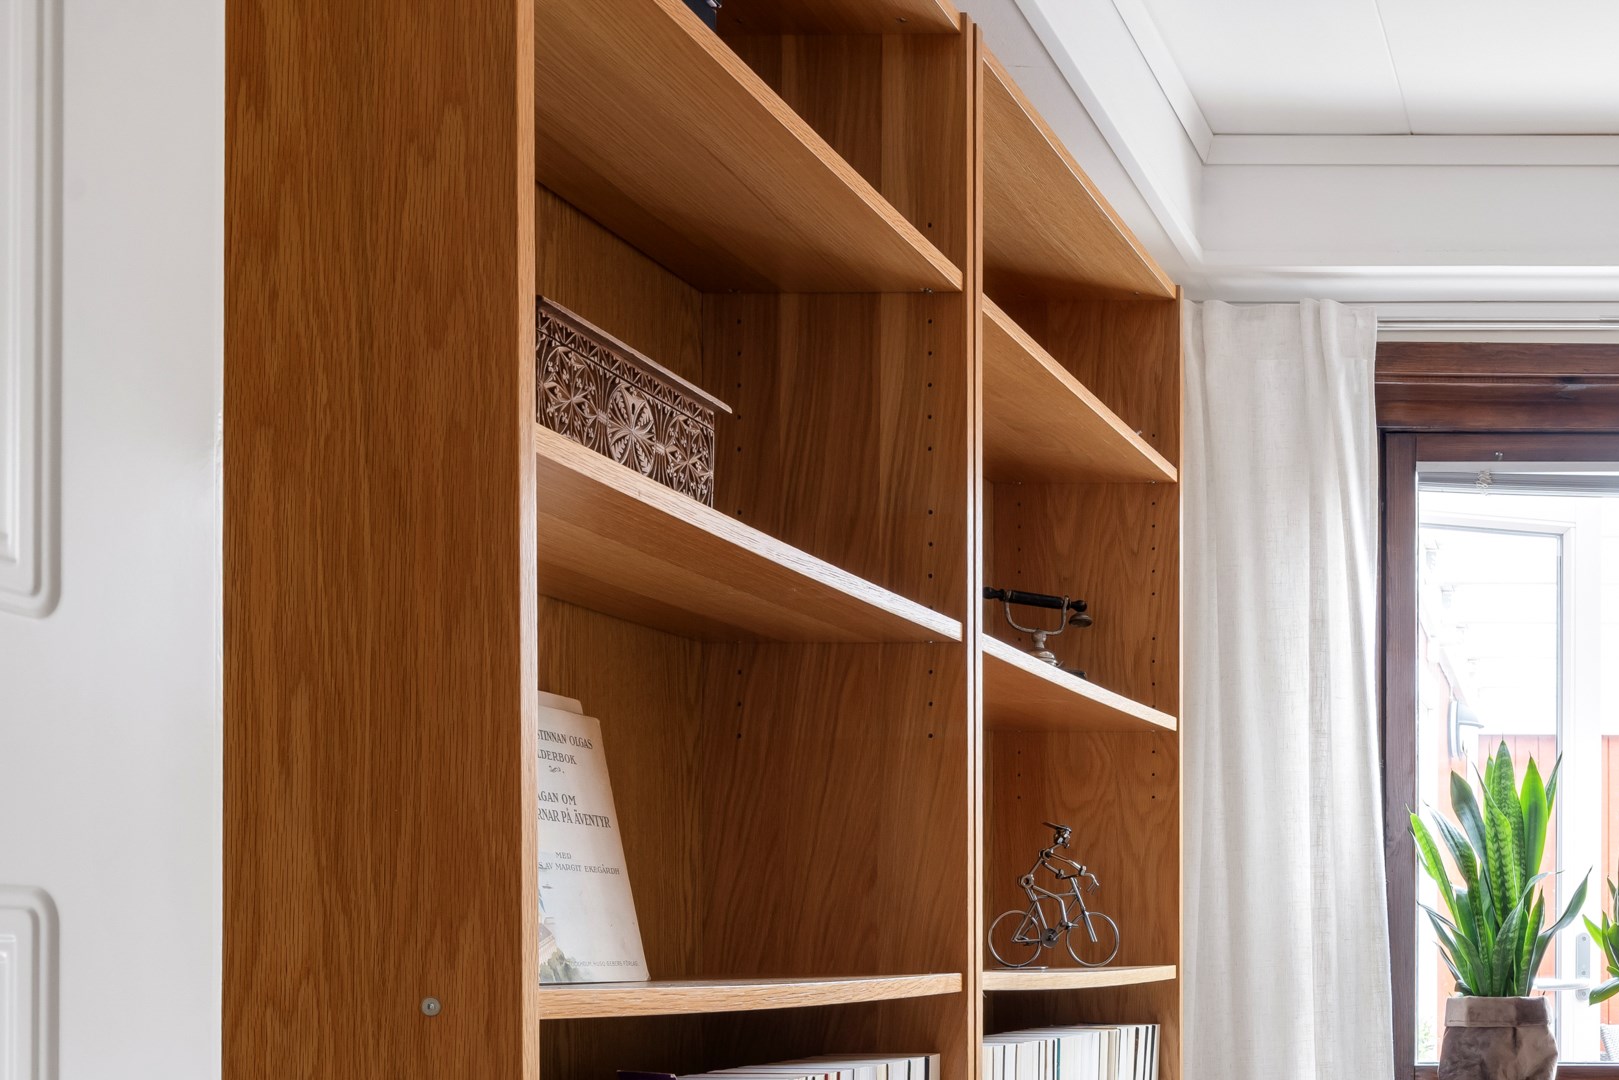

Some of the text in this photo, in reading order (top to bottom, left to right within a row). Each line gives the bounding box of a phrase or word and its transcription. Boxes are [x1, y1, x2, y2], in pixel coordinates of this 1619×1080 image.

[569, 735, 593, 749] OLGAS
[561, 793, 577, 805] OM
[561, 807, 573, 824] PÅ
[573, 809, 611, 828] ÄVENTYR
[555, 851, 572, 859] MED
[555, 863, 581, 871] MARGIT
